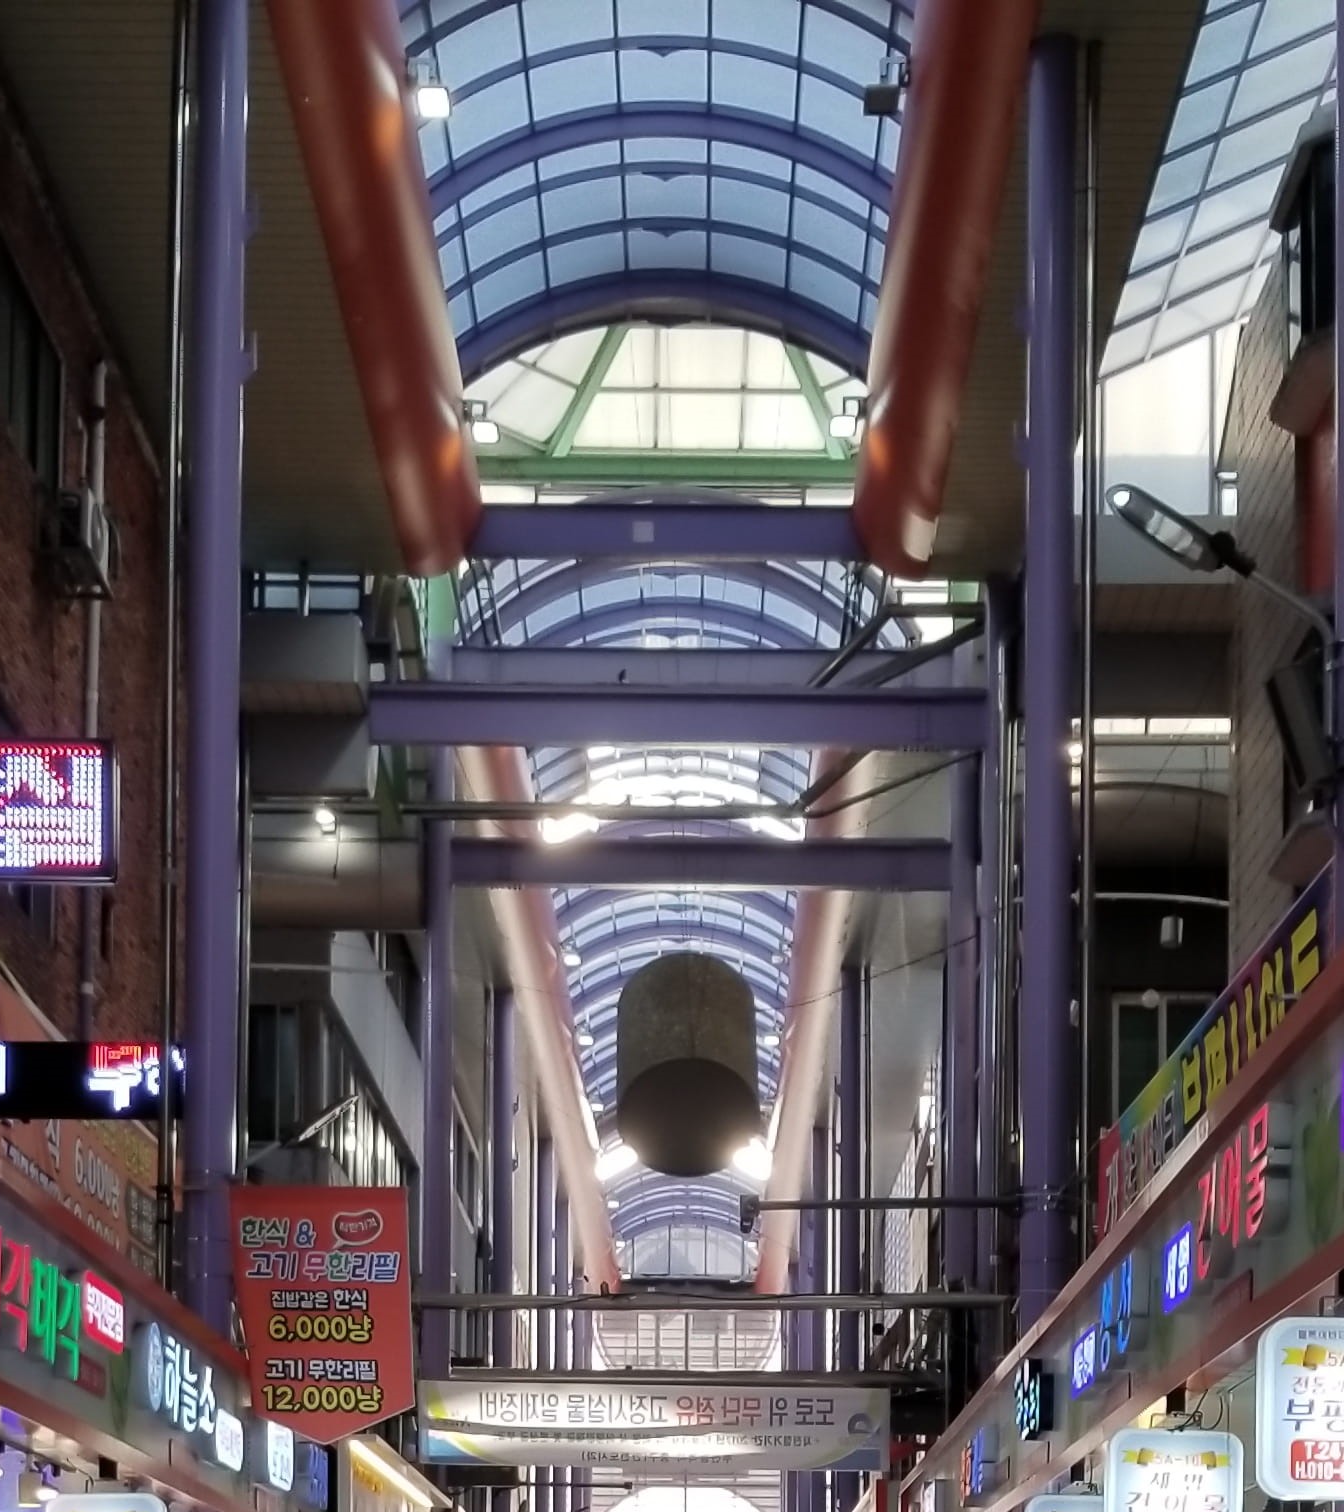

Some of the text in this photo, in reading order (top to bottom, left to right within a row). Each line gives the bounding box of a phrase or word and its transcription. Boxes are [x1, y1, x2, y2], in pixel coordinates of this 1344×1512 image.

[1197, 1104, 1271, 1280] 건어물
[240, 1215, 290, 1248] 한식
[295, 1218, 317, 1248] &
[246, 1251, 400, 1283] 고기 무한리필
[271, 1288, 368, 1310] 집밥같은 한식
[268, 1314, 373, 1343] 6,000냥
[163, 1335, 217, 1434] 하늘소
[265, 1359, 378, 1381] 고기 무한리필
[261, 1384, 383, 1413] 12,000냥
